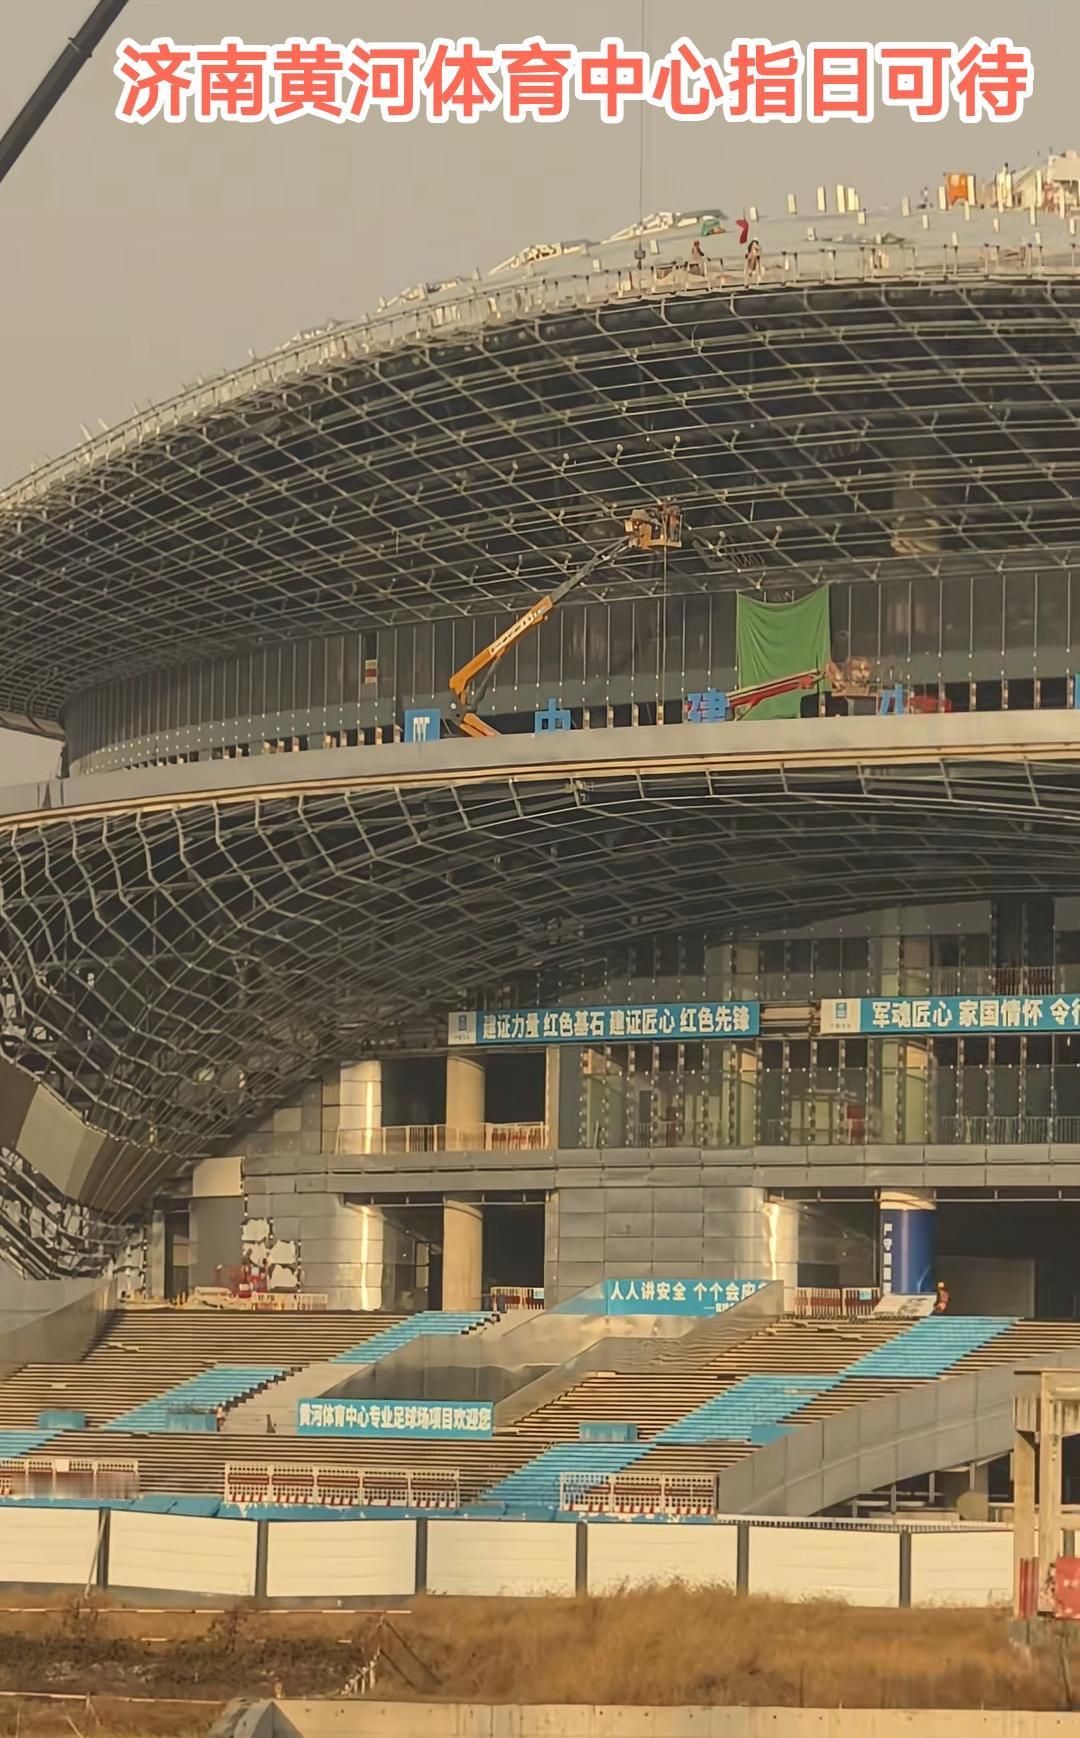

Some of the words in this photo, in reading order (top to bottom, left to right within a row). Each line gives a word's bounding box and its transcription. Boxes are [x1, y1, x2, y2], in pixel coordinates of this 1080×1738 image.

[543, 1009, 605, 1037] 红色基石
[959, 998, 1043, 1027] 家国情怀
[610, 1280, 686, 1301] 人人讲安全
[693, 1281, 768, 1302] 个个会应
